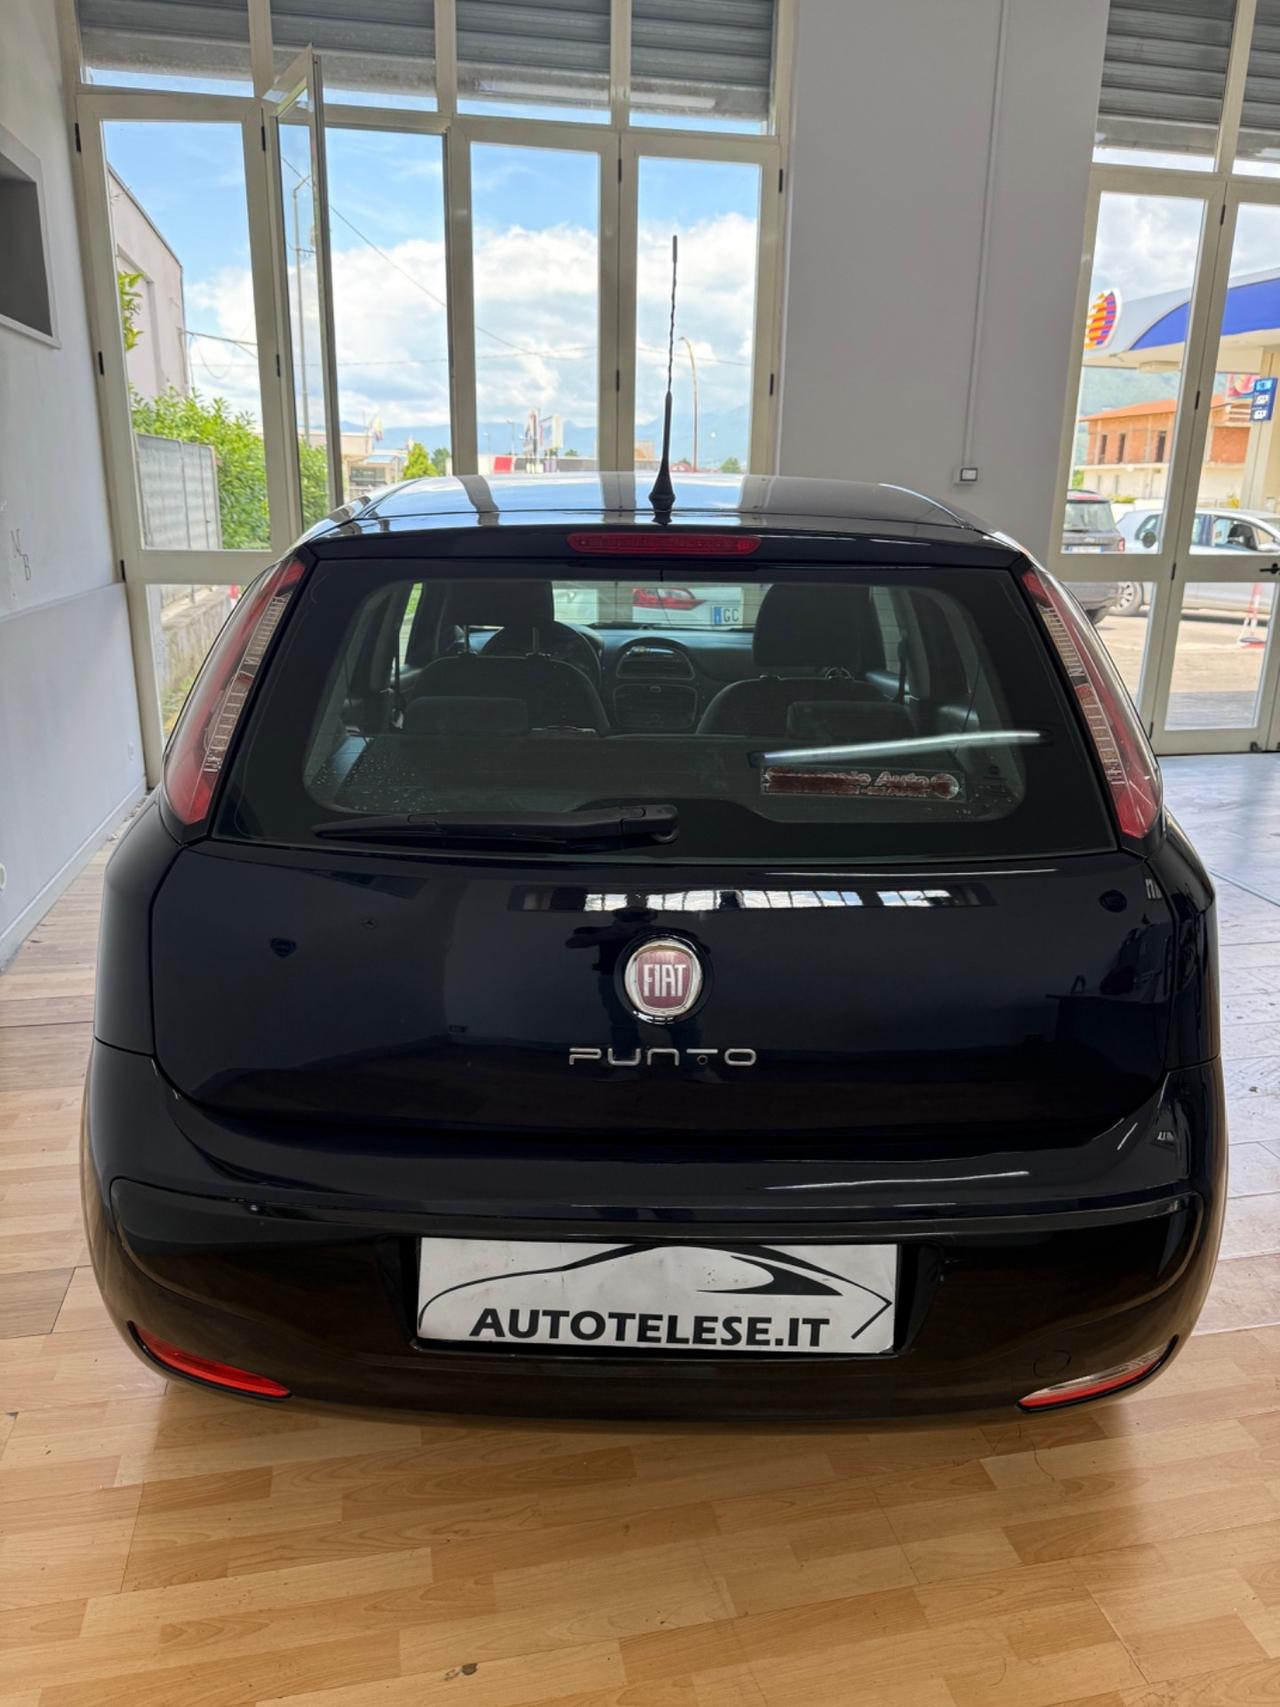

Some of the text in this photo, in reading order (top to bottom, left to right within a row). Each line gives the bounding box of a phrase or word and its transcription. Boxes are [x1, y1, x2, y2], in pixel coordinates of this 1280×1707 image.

[723, 608, 739, 623] GC
[642, 963, 687, 998] FIAT
[568, 1047, 757, 1067] PUNTO
[469, 1307, 831, 1347] AUTOTELESE.IT
